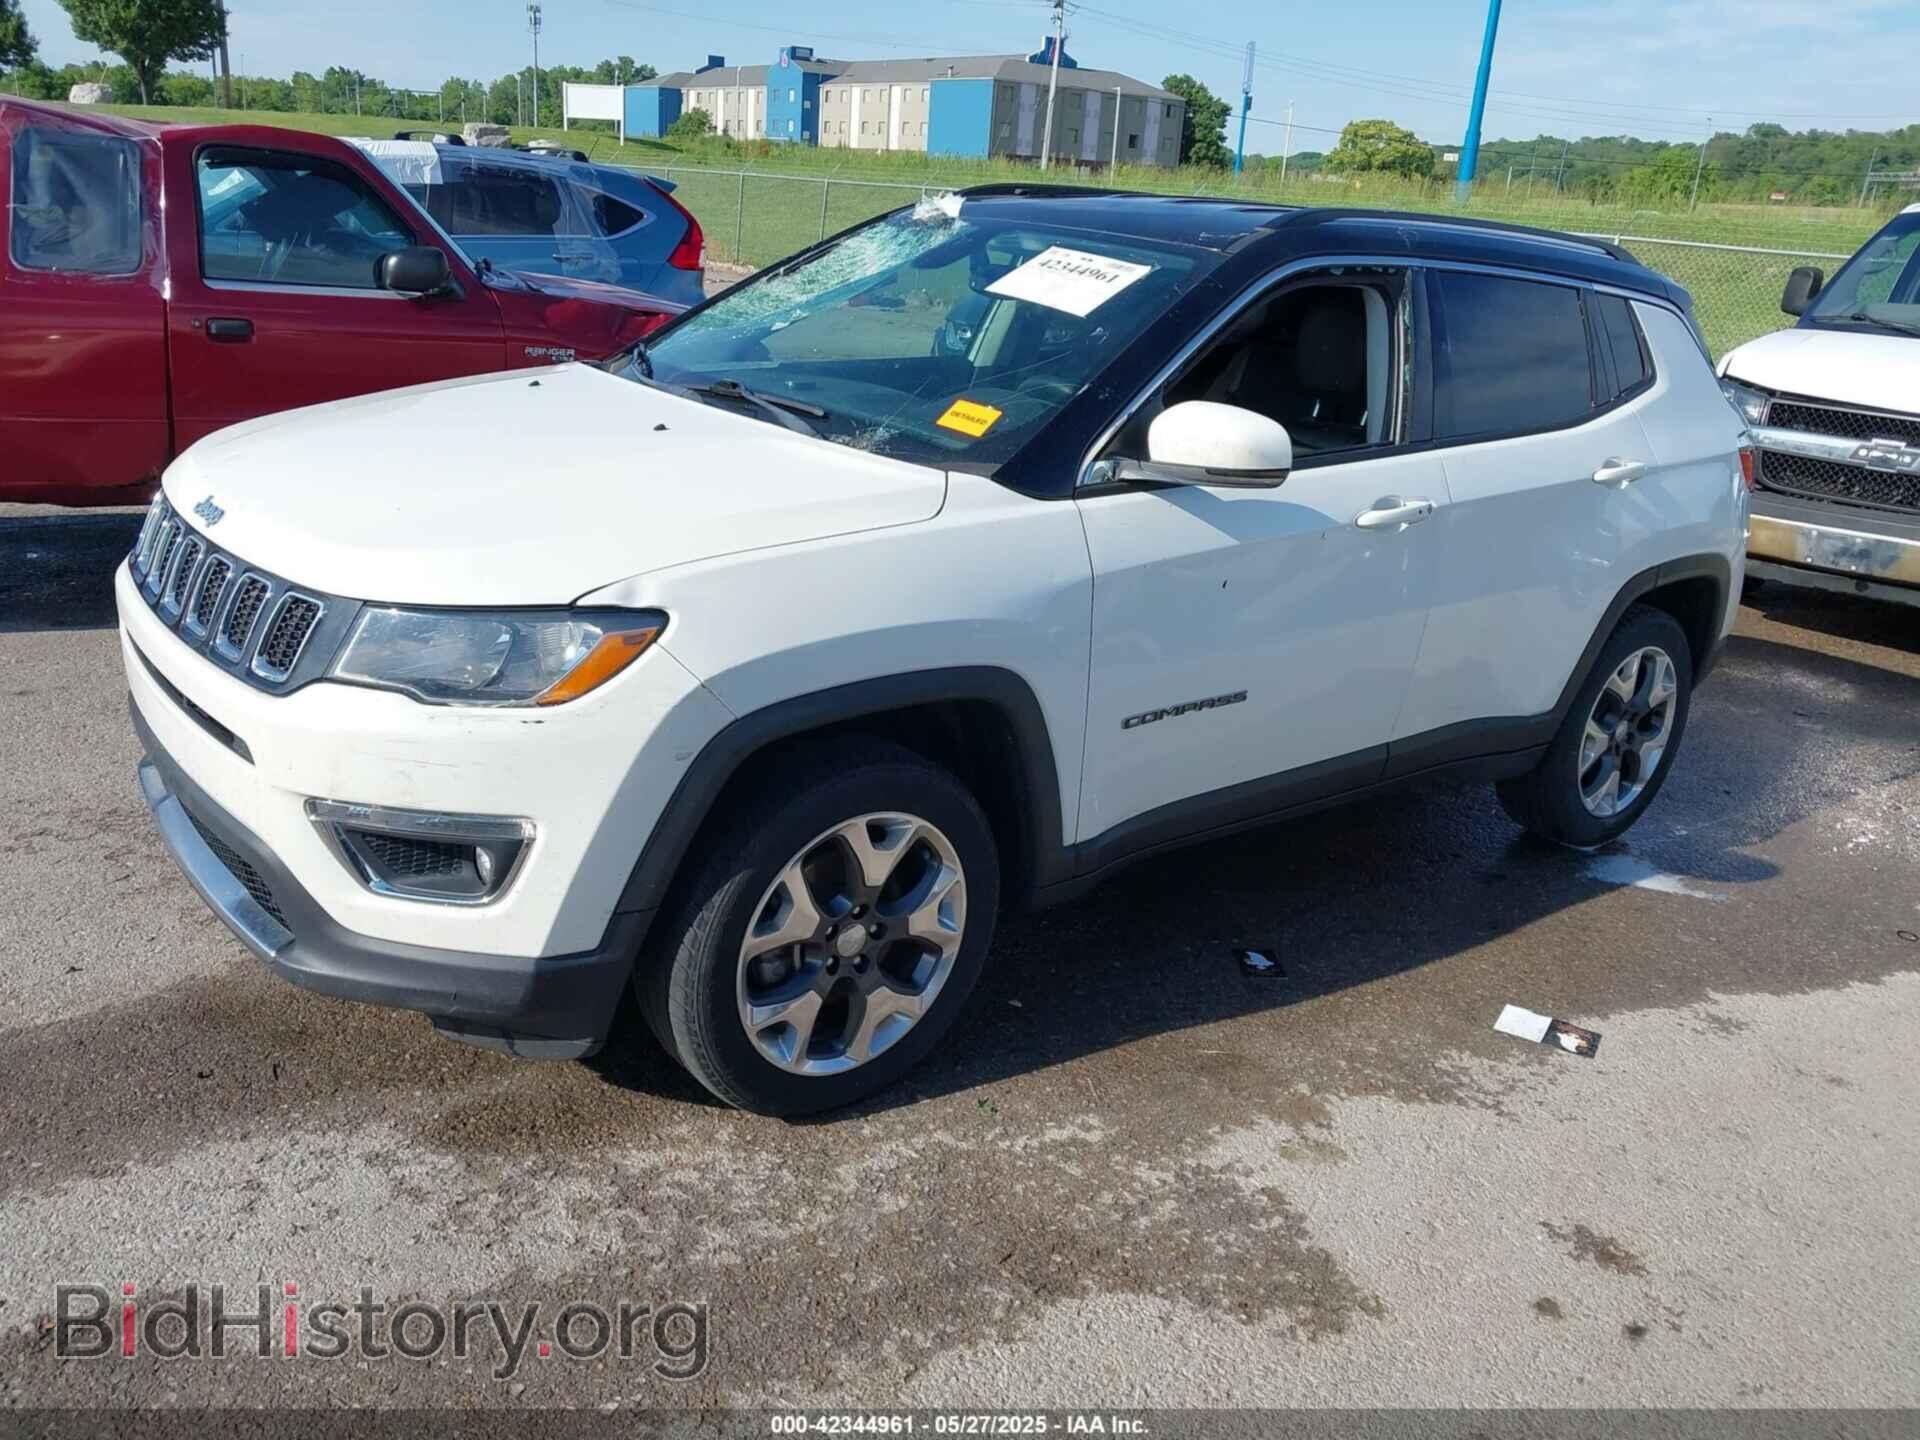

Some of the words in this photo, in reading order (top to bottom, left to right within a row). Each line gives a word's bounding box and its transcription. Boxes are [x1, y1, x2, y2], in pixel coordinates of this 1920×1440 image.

[1040, 258, 1120, 283] 42344961
[524, 346, 575, 357] RANGER
[1120, 689, 1248, 729] COMPASS
